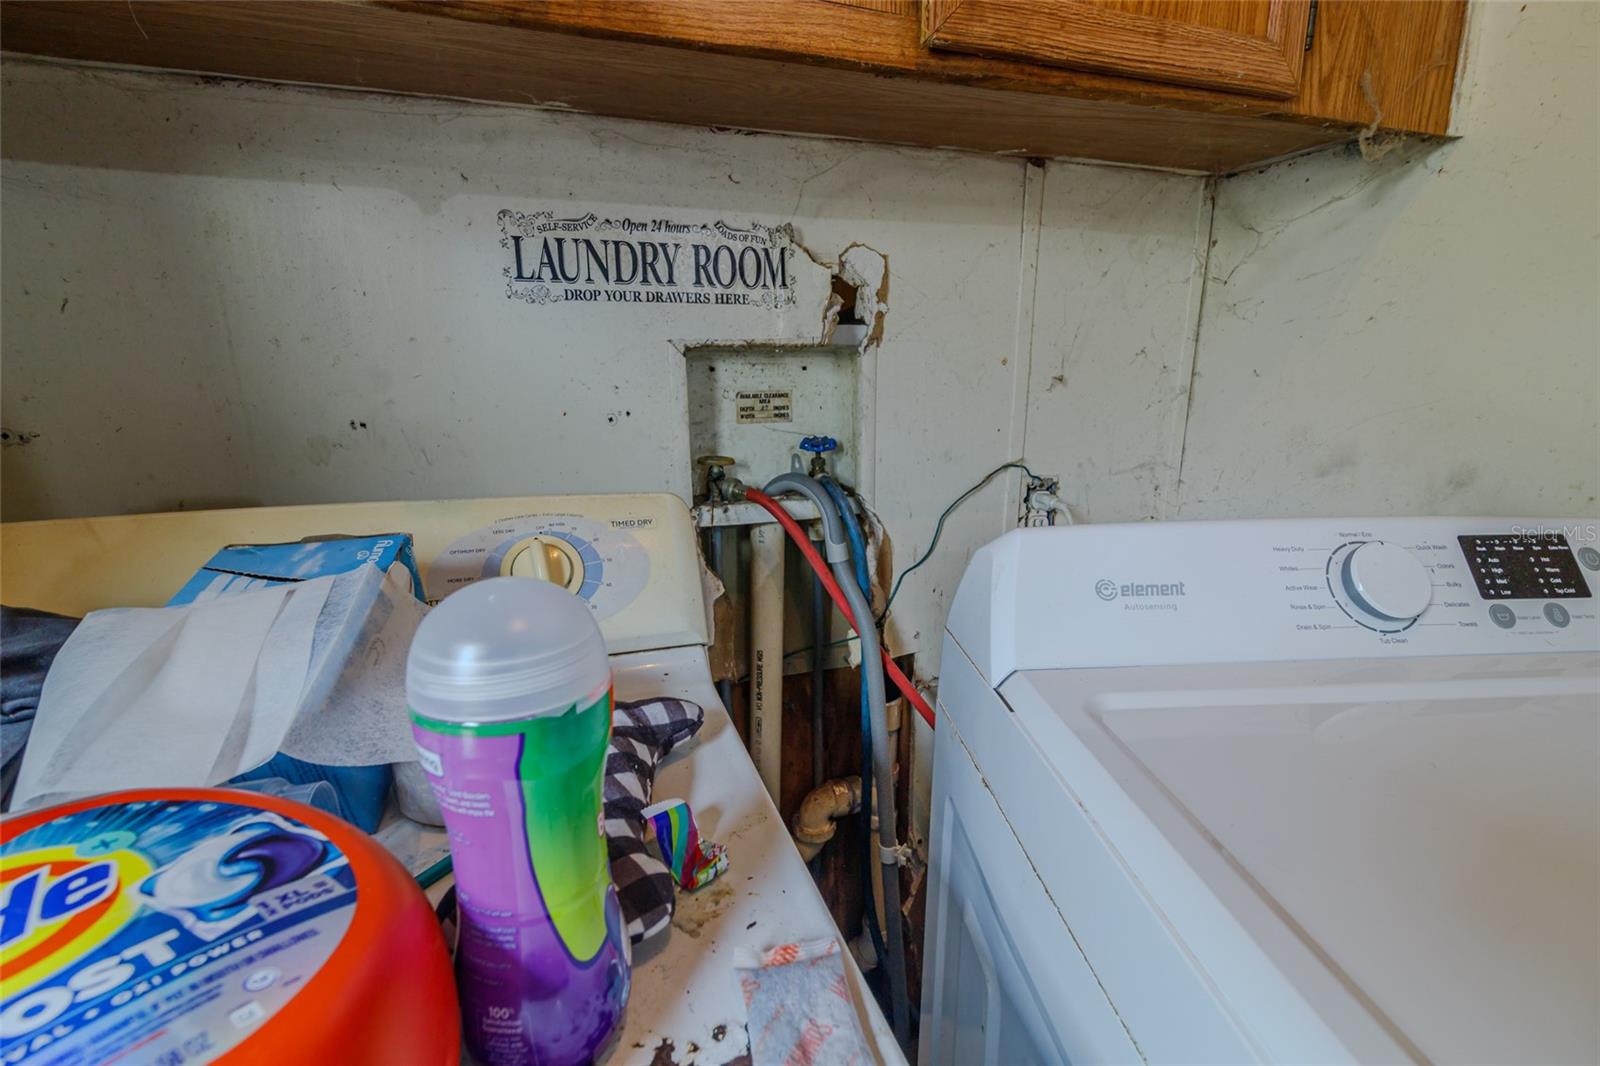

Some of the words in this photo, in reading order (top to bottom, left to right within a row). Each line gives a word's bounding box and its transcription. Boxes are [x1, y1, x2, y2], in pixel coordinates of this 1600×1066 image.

[537, 213, 598, 234] SELF-SERVICE
[622, 217, 648, 235] Open
[651, 219, 663, 233] 24
[664, 219, 692, 234] hours
[713, 221, 739, 242] LOADS
[739, 234, 750, 242] OF
[750, 234, 768, 245] FUN
[511, 236, 680, 287] LAUNDRY
[692, 244, 790, 290] ROOM
[564, 288, 601, 302] DROP
[604, 289, 642, 303] YOUR
[646, 291, 711, 305] DRAWERS
[714, 293, 751, 306] HERE
[611, 519, 636, 528] TIMED
[637, 518, 653, 526] DRY
[449, 548, 475, 556] OPTIMUM
[1120, 581, 1186, 597] element
[1124, 603, 1178, 612] Autosensing
[110, 974, 163, 1006] OXI
[170, 928, 264, 977] POWER
